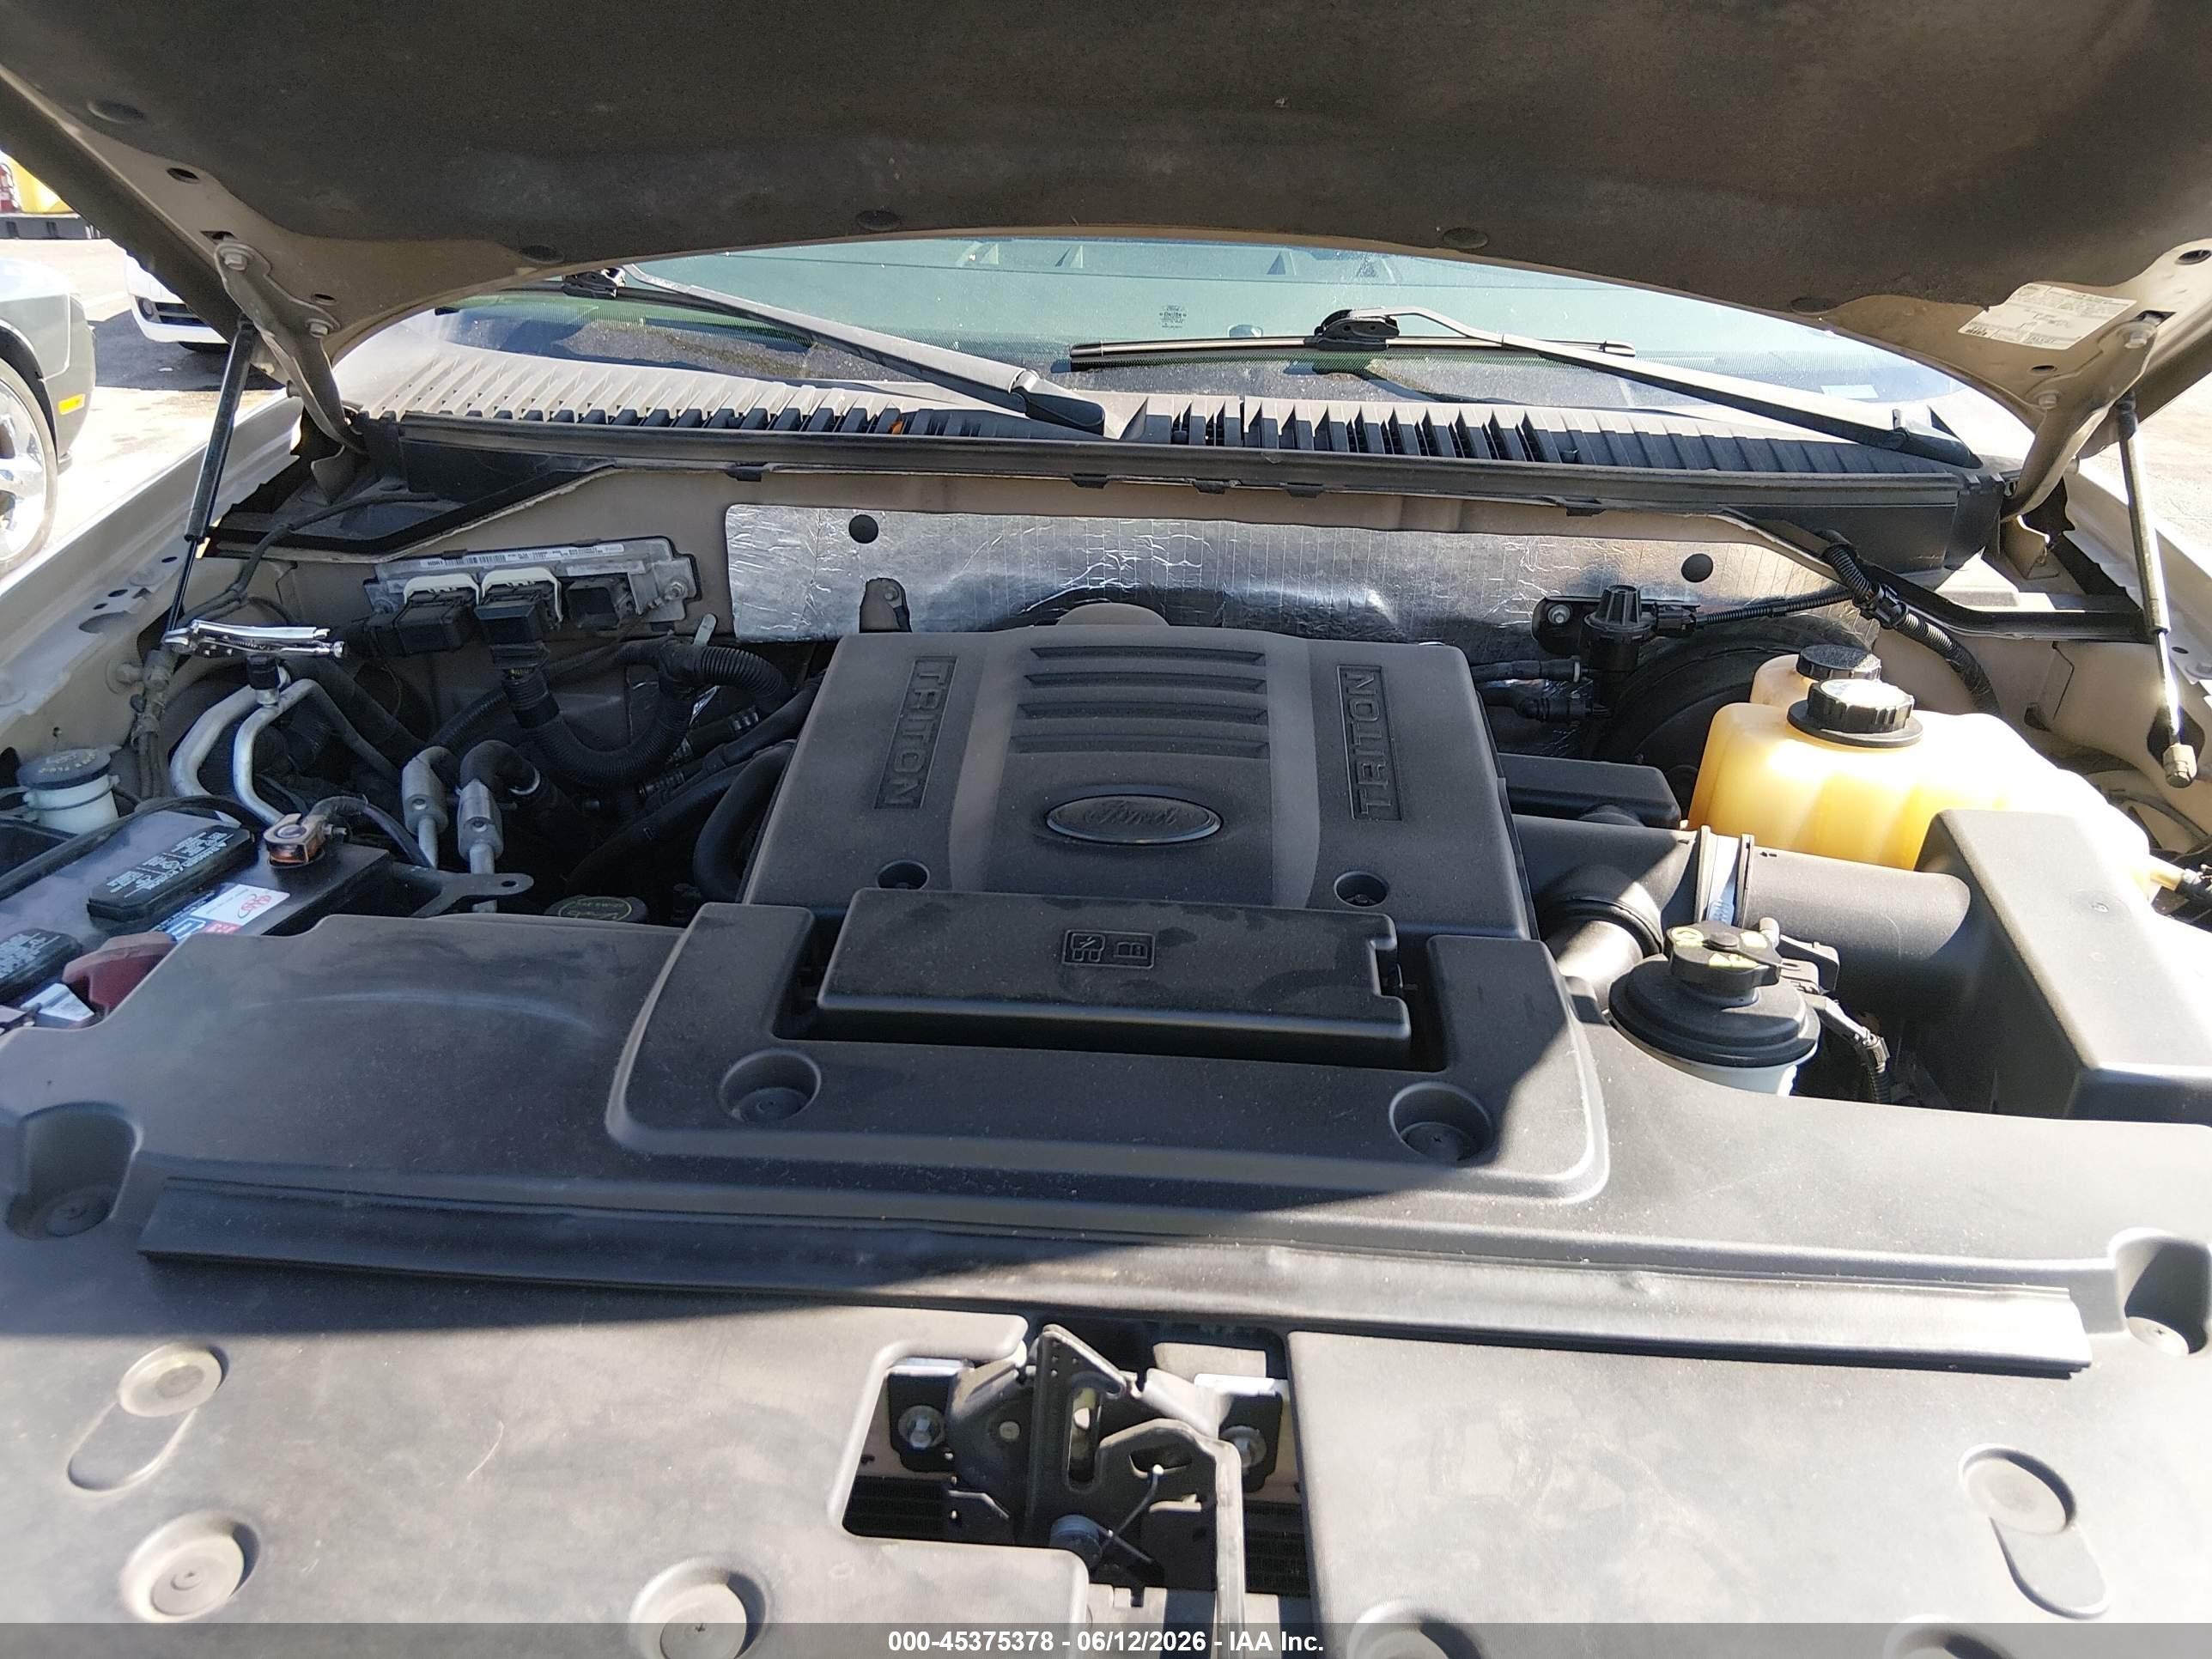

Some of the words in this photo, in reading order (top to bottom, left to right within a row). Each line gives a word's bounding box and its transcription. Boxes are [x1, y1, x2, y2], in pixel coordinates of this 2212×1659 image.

[884, 662, 949, 805] TRITON
[1345, 672, 1392, 815] TRITON
[1084, 799, 1178, 826] Ford
